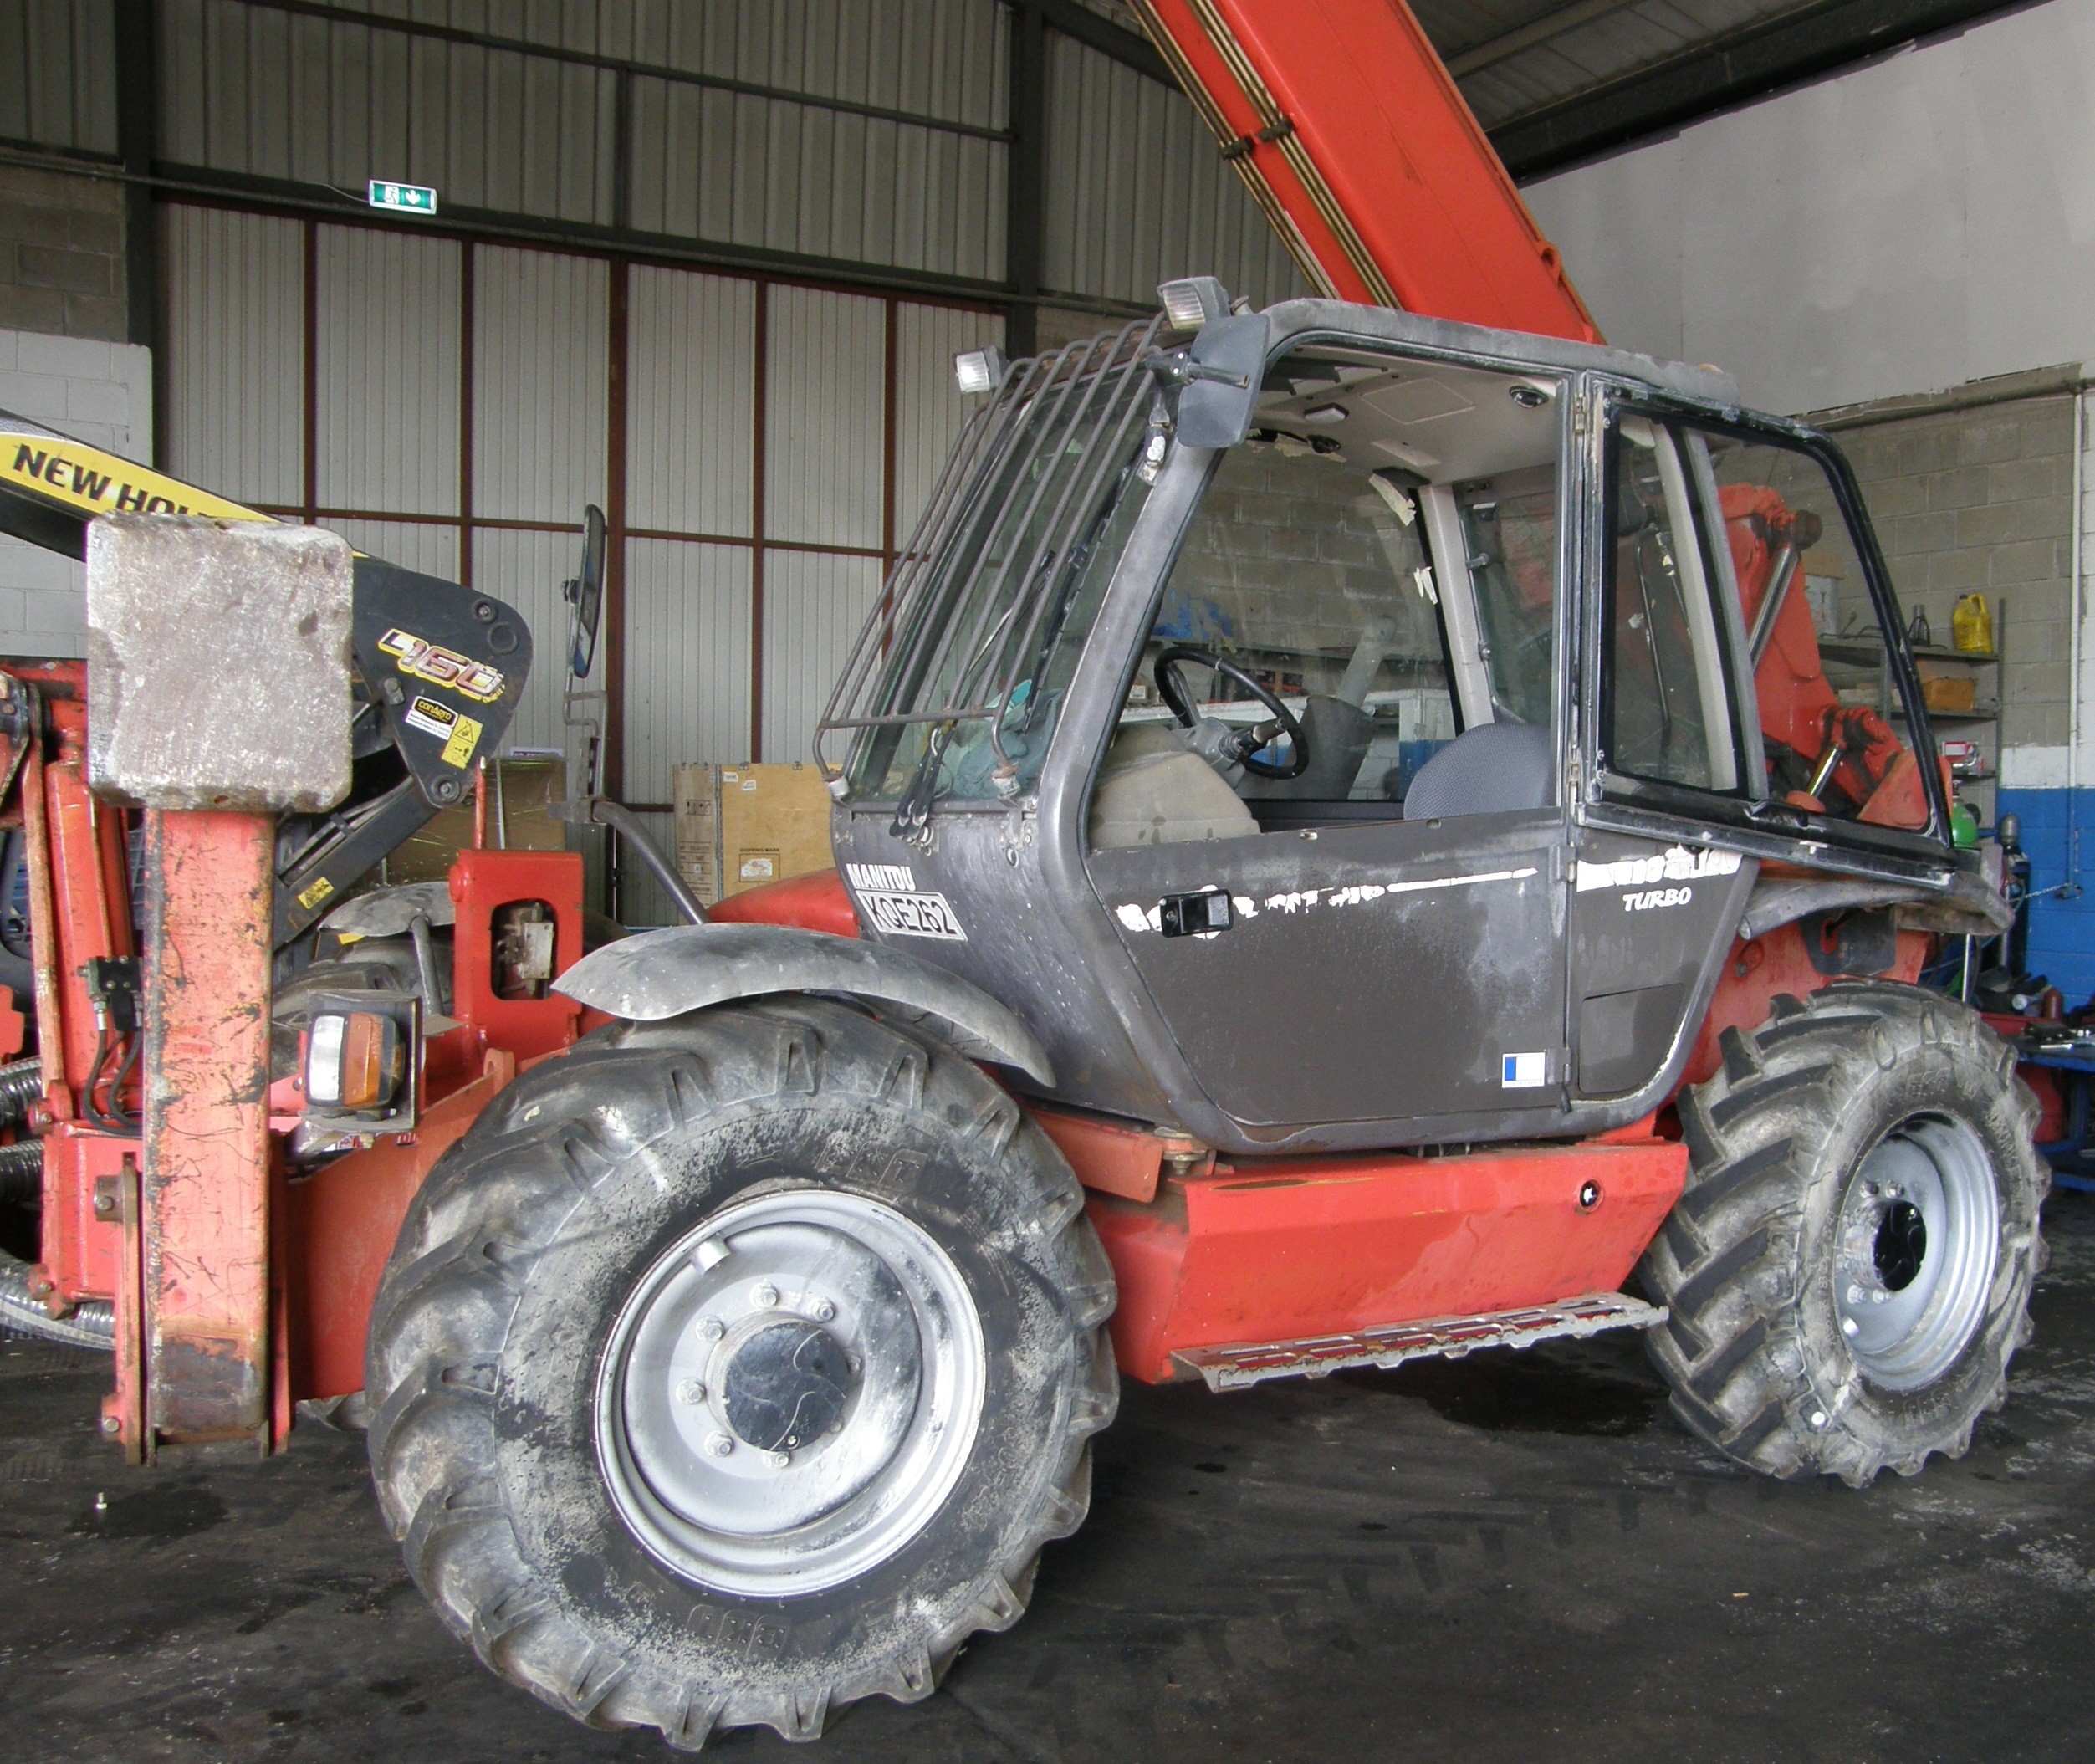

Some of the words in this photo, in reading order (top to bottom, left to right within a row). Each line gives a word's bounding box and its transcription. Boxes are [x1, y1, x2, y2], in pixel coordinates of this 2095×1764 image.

[13, 443, 112, 502] NEW
[846, 863, 916, 892] MANITOU
[862, 894, 958, 935] KQE262
[1622, 887, 1692, 912] TURBO
